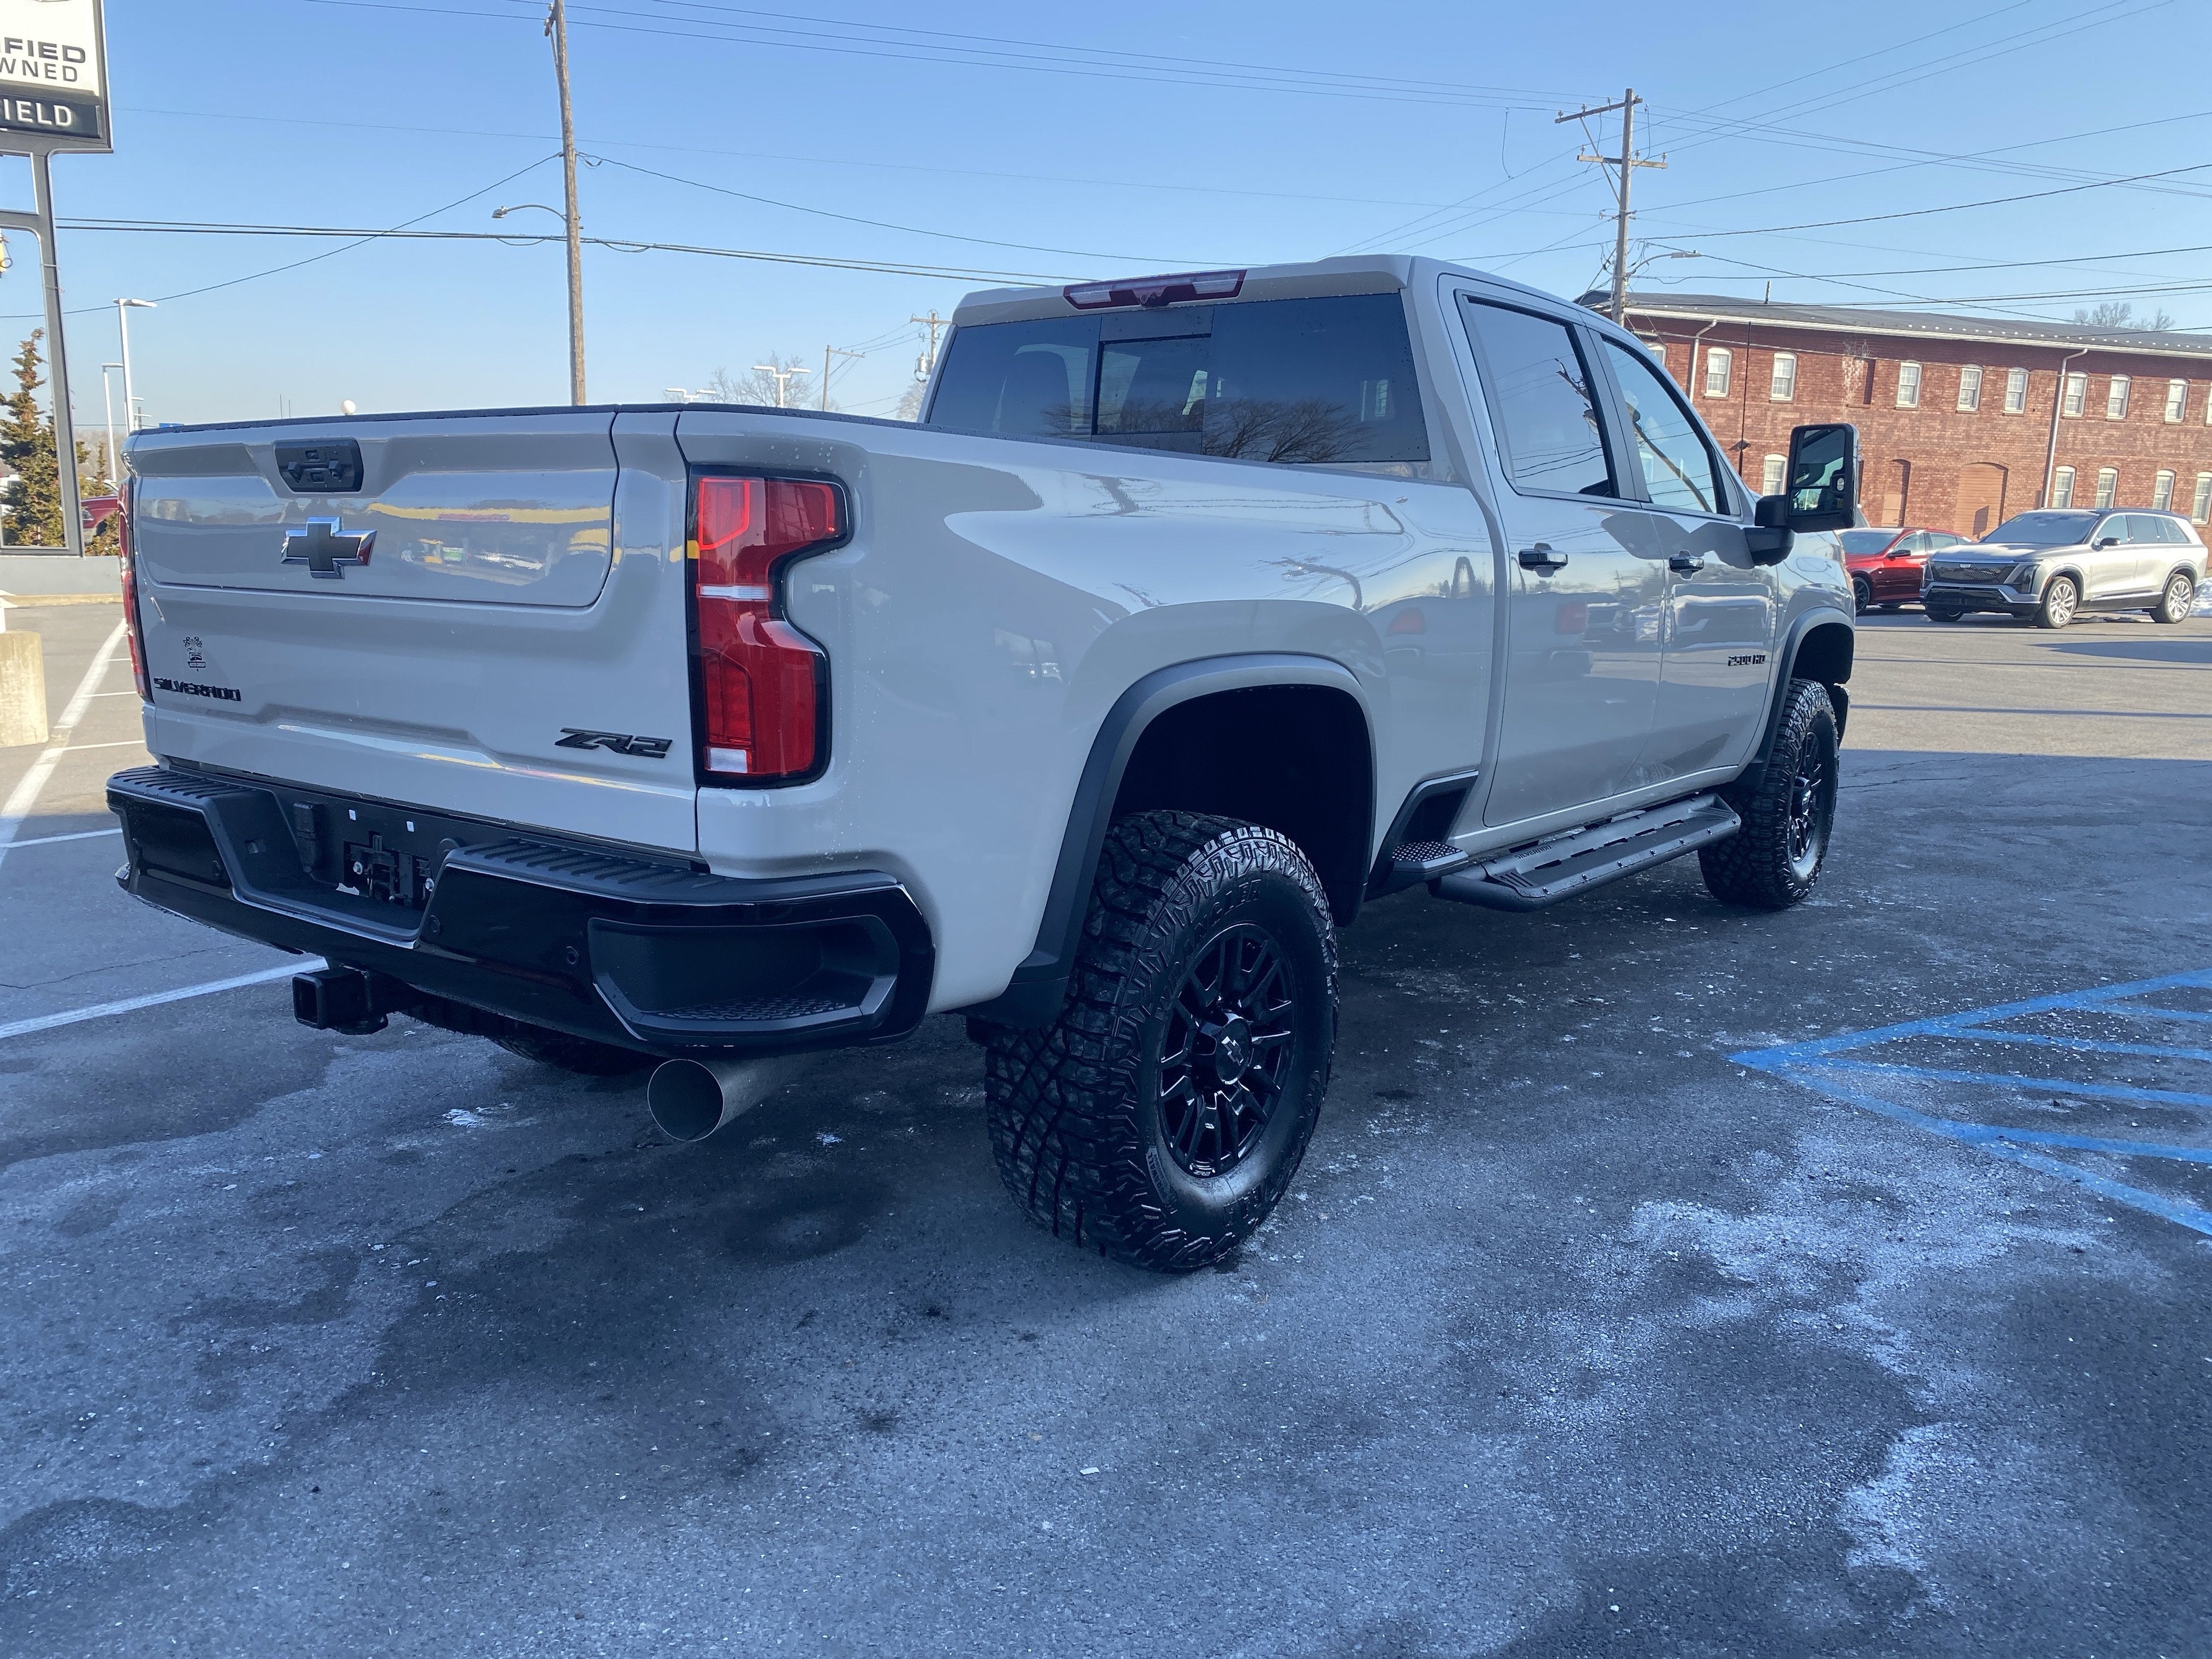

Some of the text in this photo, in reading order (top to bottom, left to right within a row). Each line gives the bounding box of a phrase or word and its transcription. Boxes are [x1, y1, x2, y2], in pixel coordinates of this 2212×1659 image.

[3, 98, 72, 127] IELD
[153, 678, 241, 702] SILVERADO
[554, 727, 673, 759] ZR2
[1514, 844, 1552, 860] SILVERADO
